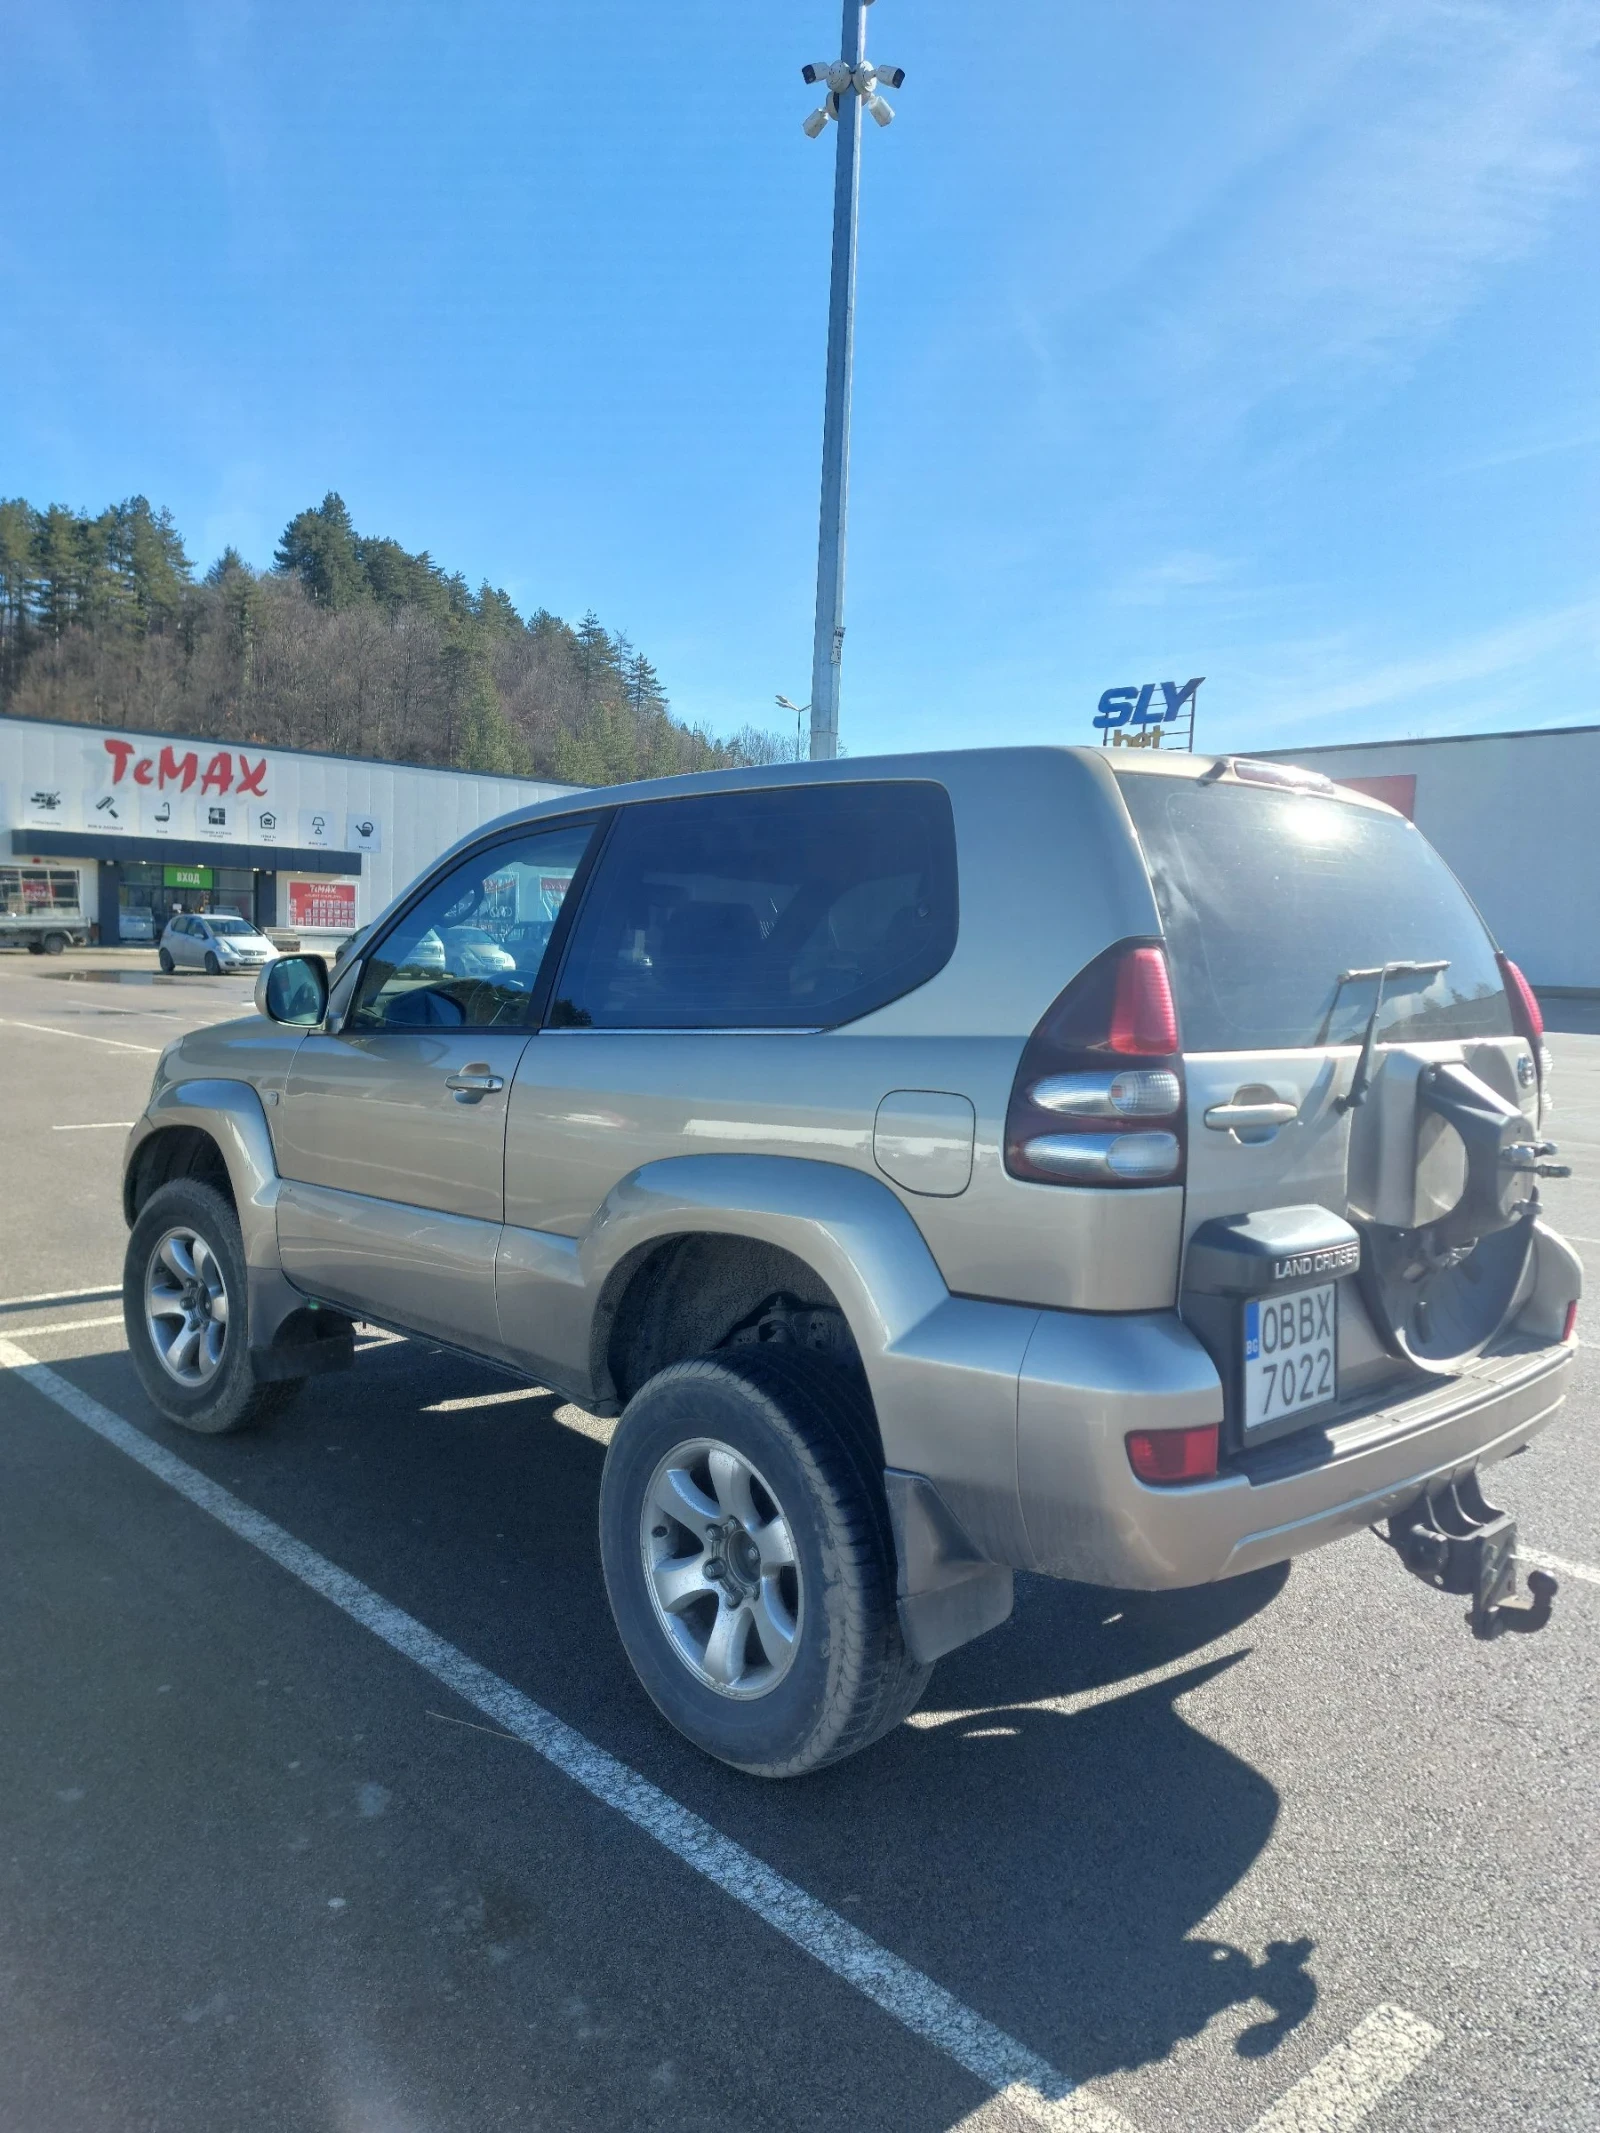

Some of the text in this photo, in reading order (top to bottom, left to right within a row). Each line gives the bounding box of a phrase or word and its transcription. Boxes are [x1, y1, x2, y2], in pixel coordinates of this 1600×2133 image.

[1092, 677, 1206, 728] SLY
[176, 871, 200, 884] ВХОД
[1275, 1246, 1359, 1279] LAND CRUISER
[1263, 1291, 1332, 1355] OBBX
[1246, 1339, 1259, 1354] BG
[1262, 1348, 1332, 1415] 7022
